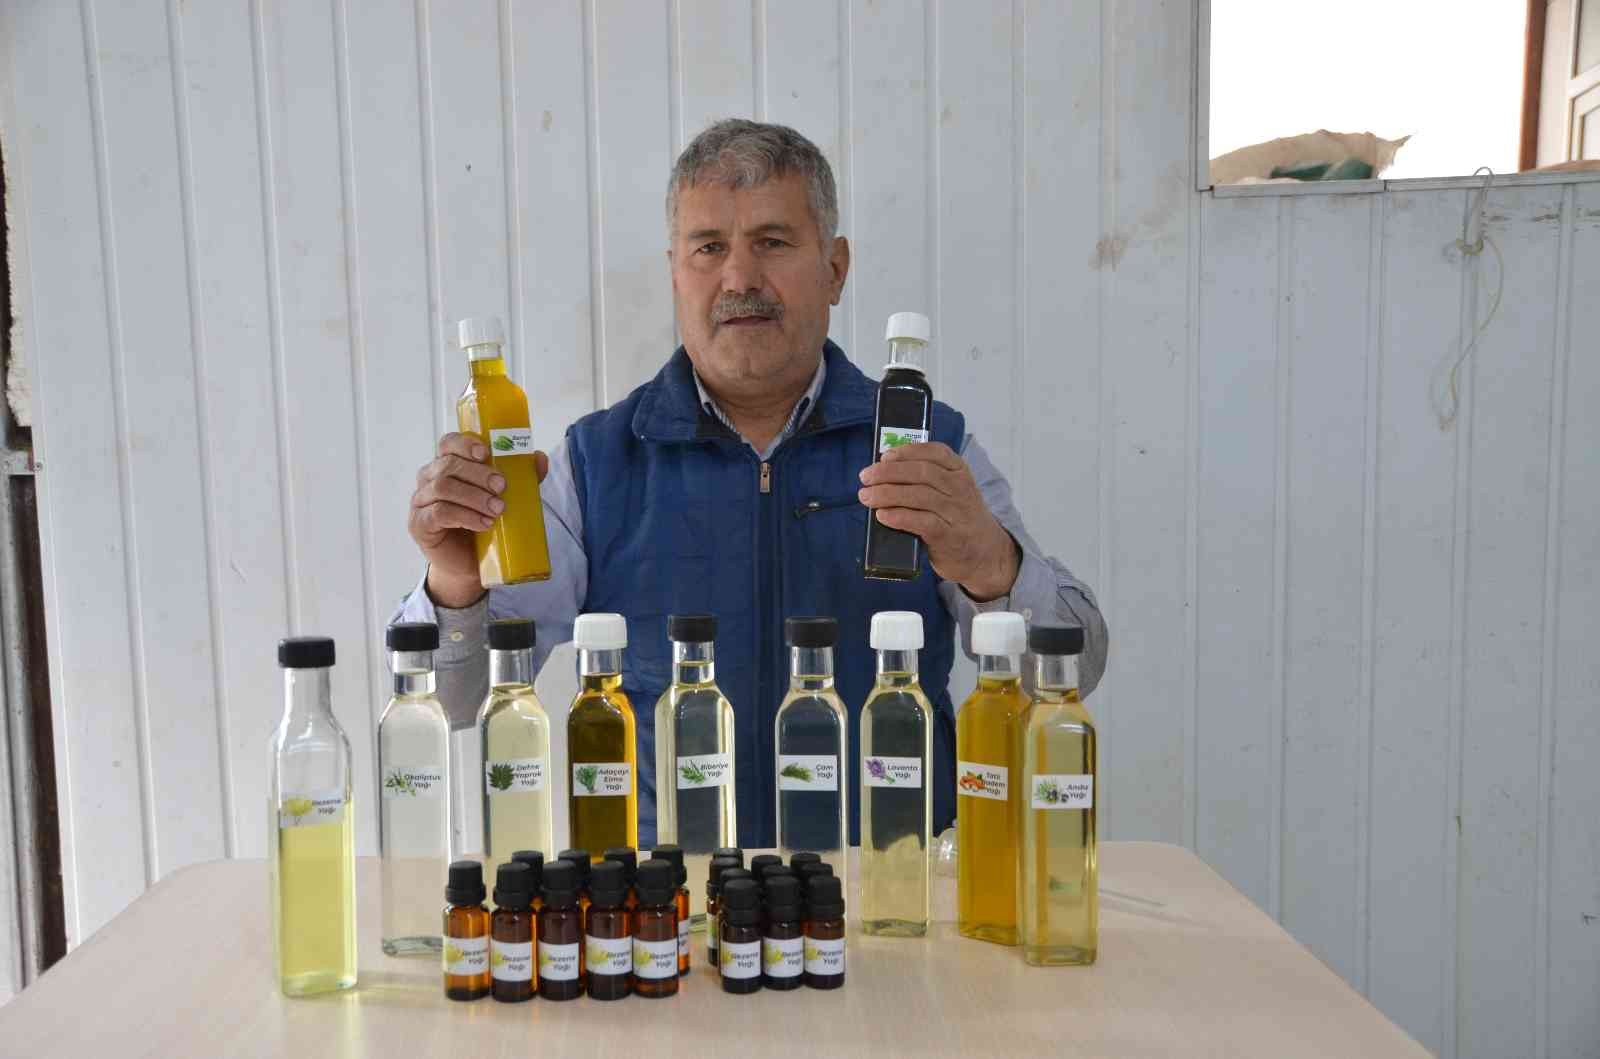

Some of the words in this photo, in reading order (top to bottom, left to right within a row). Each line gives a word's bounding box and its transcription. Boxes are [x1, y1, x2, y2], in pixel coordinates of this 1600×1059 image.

[516, 763, 540, 771] Defne
[700, 762, 729, 772] Biberiye
[815, 764, 834, 773] Çam
[514, 771, 542, 780] Yaprak
[598, 768, 629, 778] Adaçayı
[707, 771, 723, 779] Yağı
[817, 772, 833, 780] Yağı
[895, 772, 912, 780] Yağı
[404, 773, 441, 783] Okaliptus
[414, 782, 432, 790] Yağı
[521, 779, 538, 788] Yağı
[605, 784, 622, 792] Yağı
[986, 787, 1001, 796] Yağı
[1070, 792, 1087, 800] Yağı
[318, 806, 336, 815] Yağı
[730, 952, 759, 960] Rezene
[507, 963, 527, 972] Yağı
[553, 964, 572, 972] Yağı
[737, 961, 755, 969] Yağı
